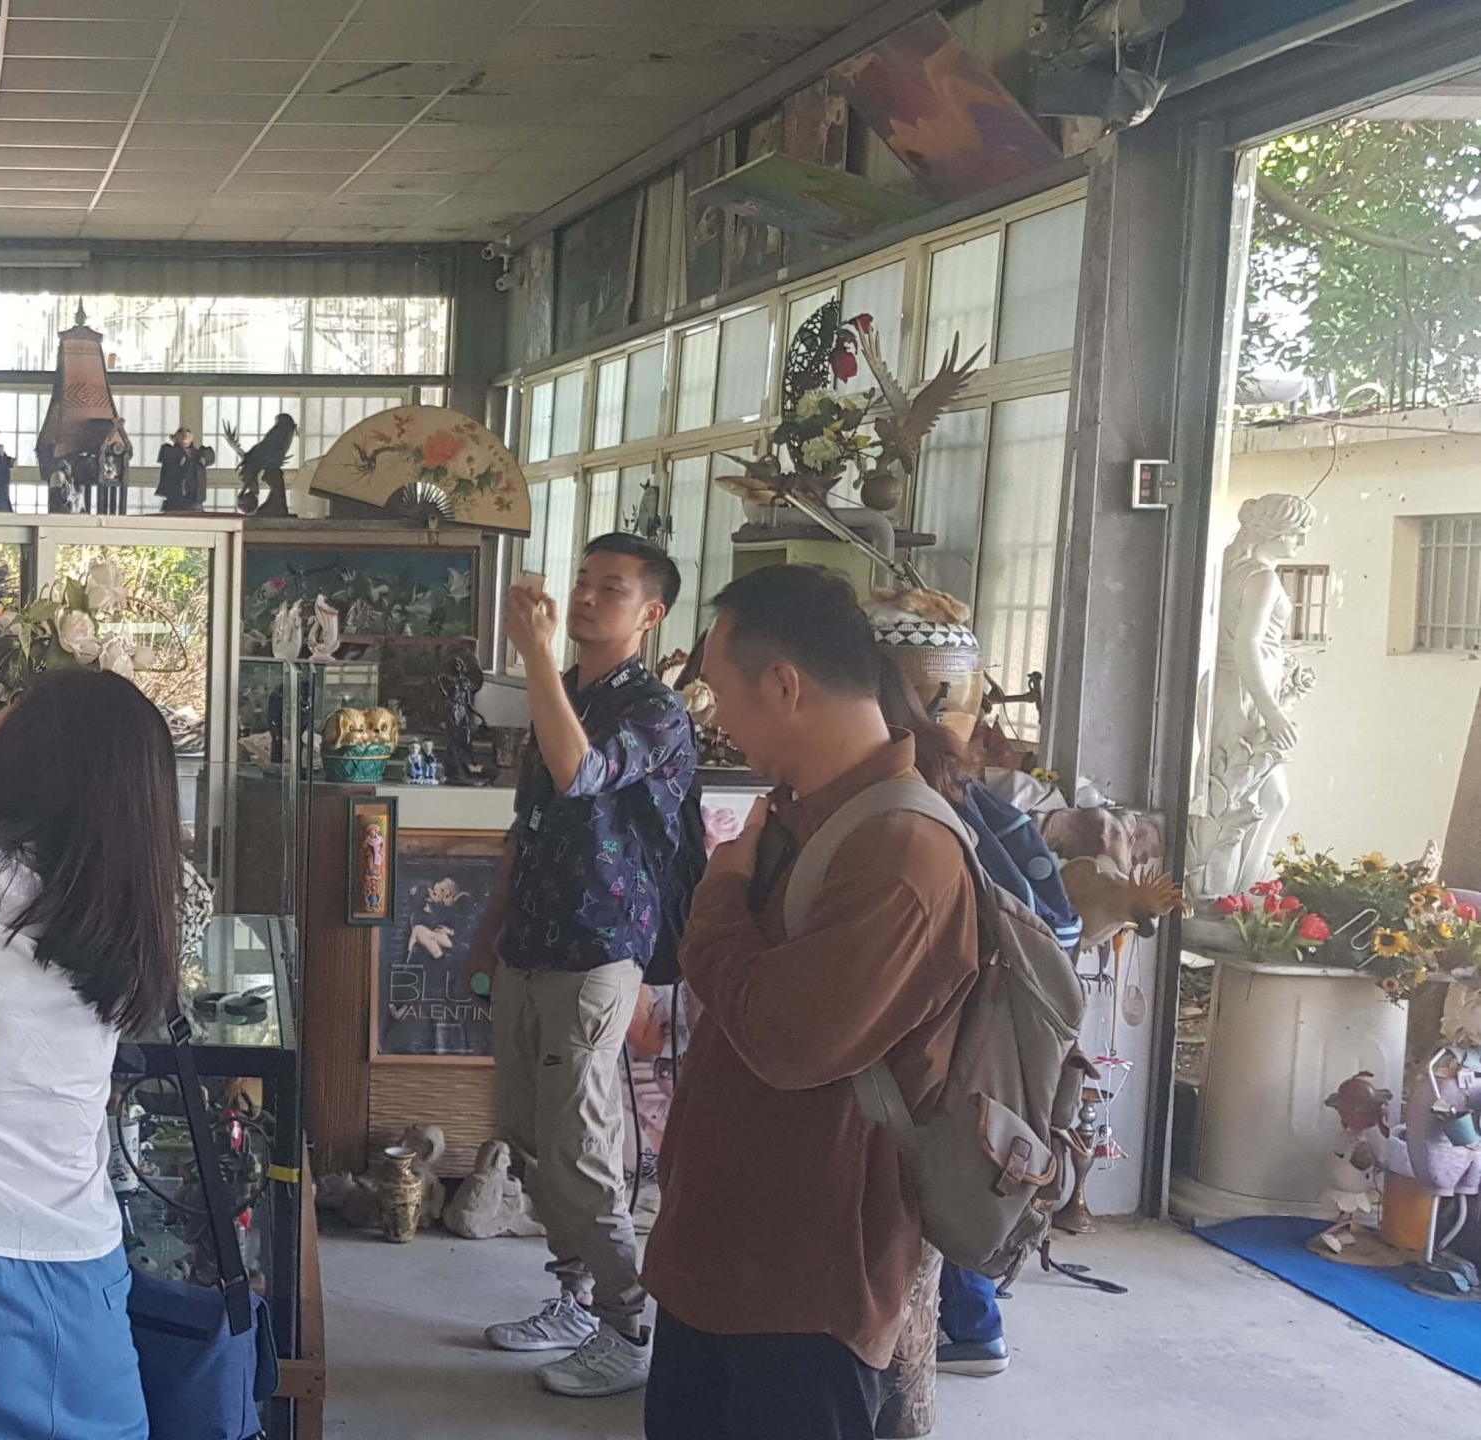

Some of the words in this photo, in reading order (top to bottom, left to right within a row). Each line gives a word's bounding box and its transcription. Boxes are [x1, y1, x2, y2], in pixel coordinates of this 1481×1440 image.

[610, 668, 631, 689] NIKE
[389, 969, 474, 1003] BLU
[388, 1003, 493, 1021] VALENTIN
